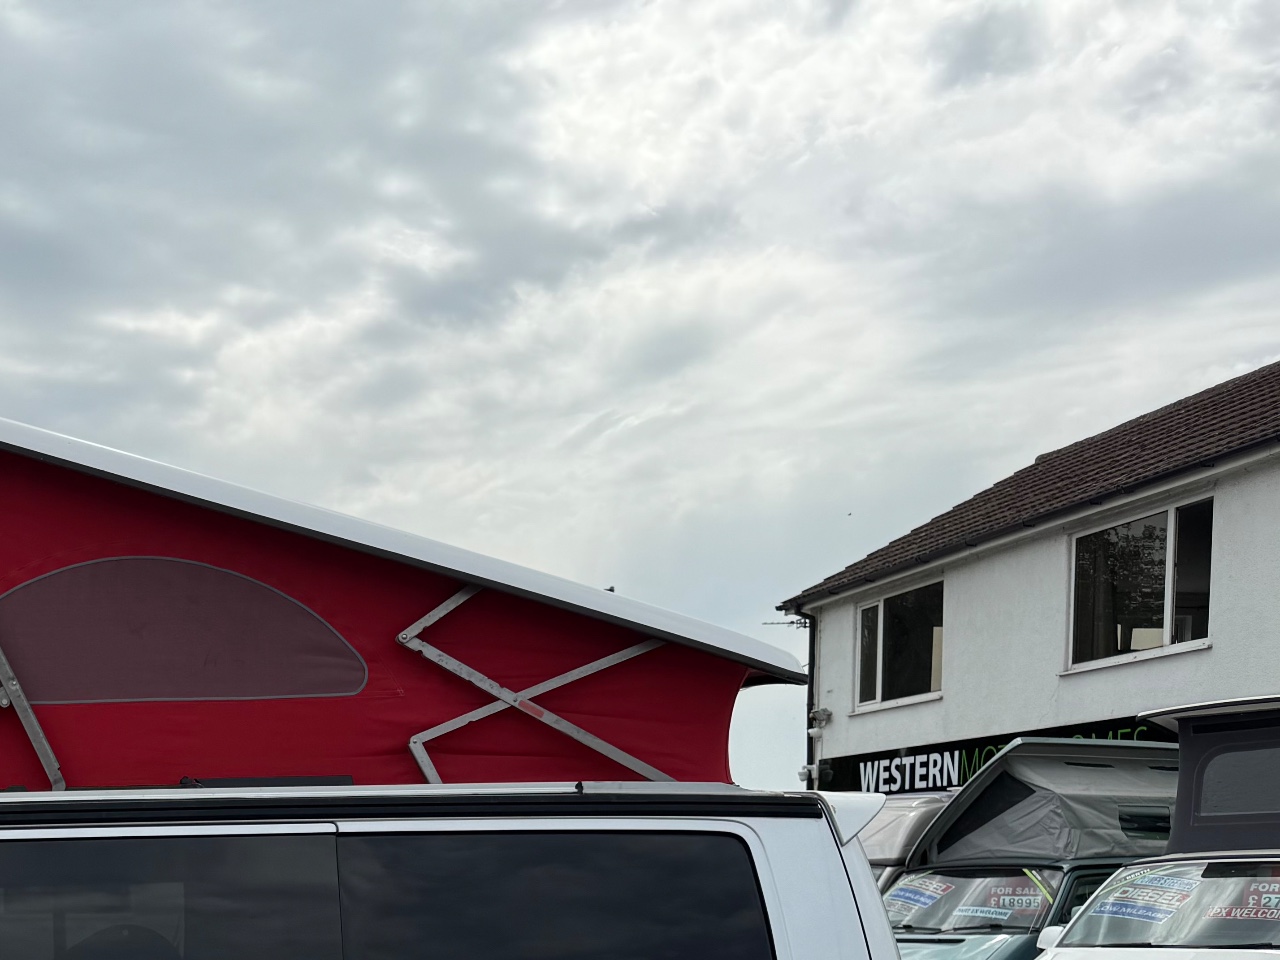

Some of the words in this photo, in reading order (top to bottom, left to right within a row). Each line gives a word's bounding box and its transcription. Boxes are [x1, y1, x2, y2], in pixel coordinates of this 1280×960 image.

[991, 887, 1012, 895] FOR
[1249, 883, 1280, 892] FOR
[1113, 886, 1183, 905] DIESEL
[1096, 903, 1119, 912] LOW
[1120, 907, 1167, 918] MILEAGE
